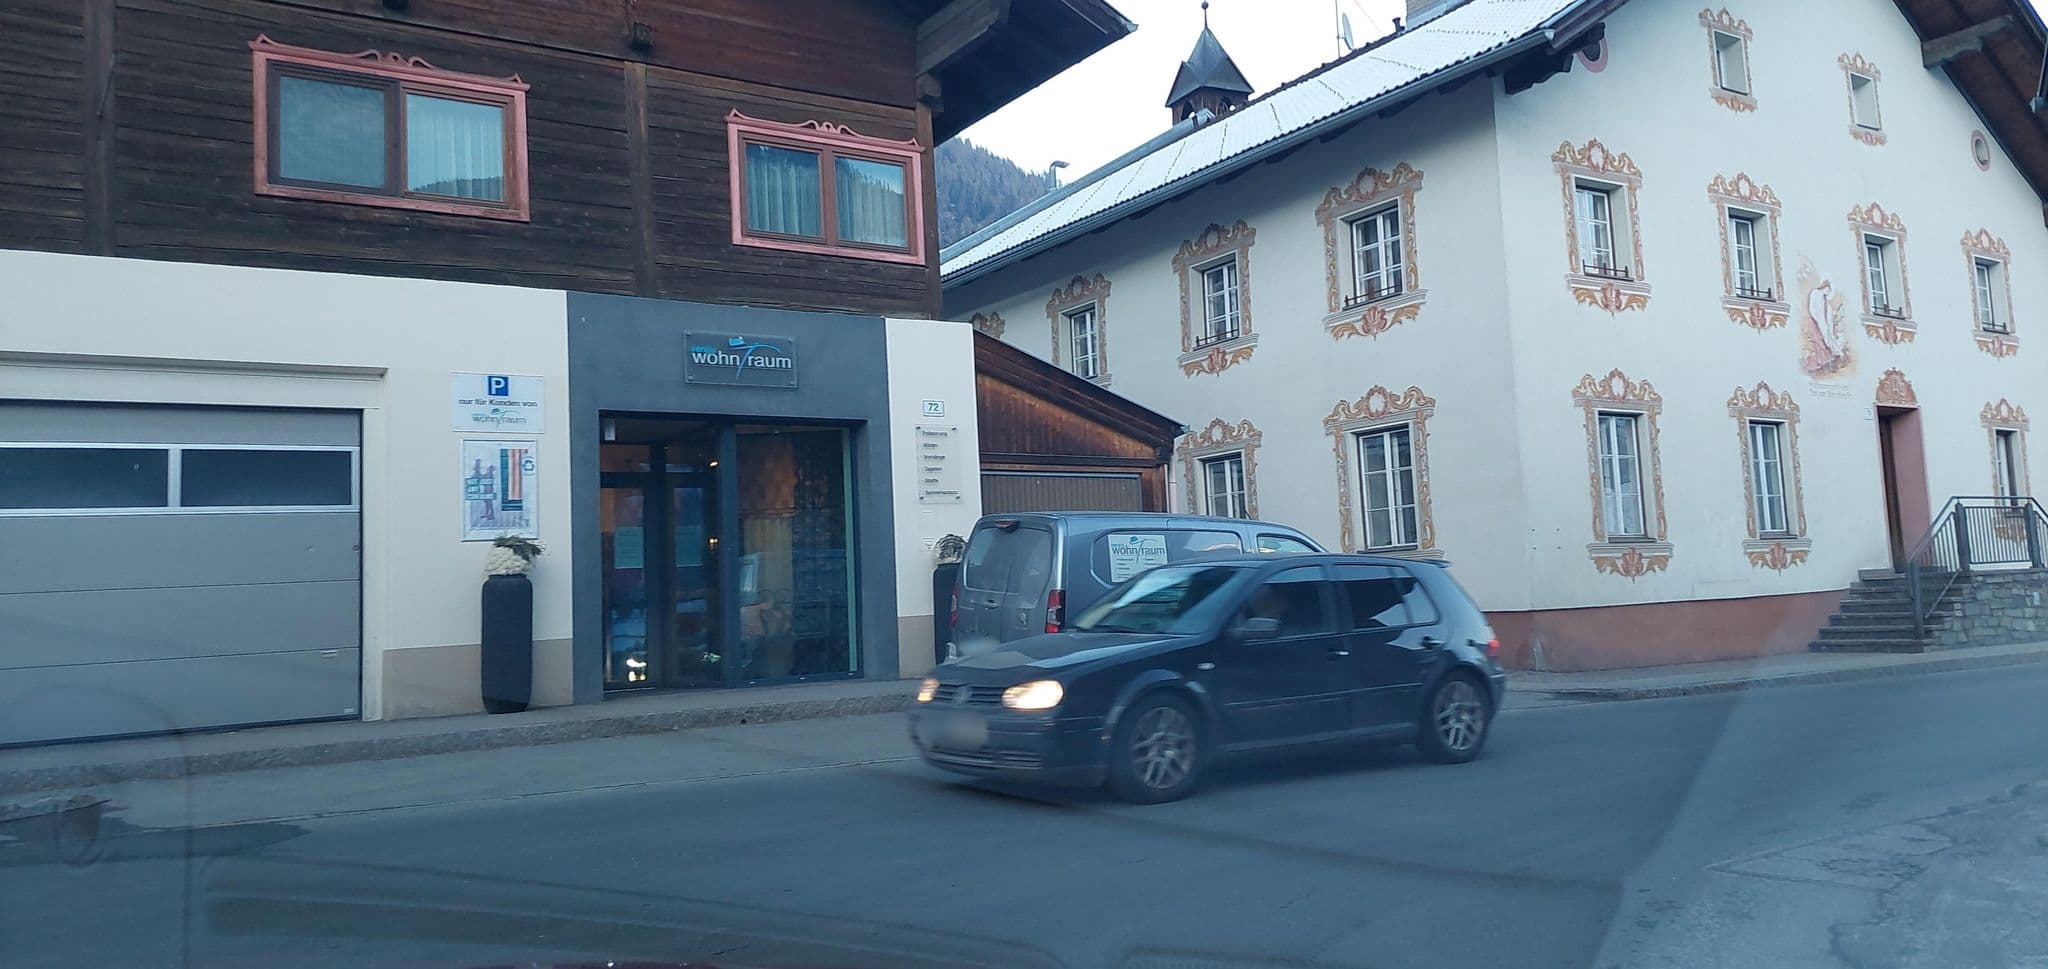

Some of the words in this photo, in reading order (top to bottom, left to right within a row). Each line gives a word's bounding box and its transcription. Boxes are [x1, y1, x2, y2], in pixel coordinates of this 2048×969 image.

[490, 377, 506, 395] P
[475, 398, 487, 406] für
[489, 399, 521, 407] Kunden
[927, 402, 940, 412] 72
